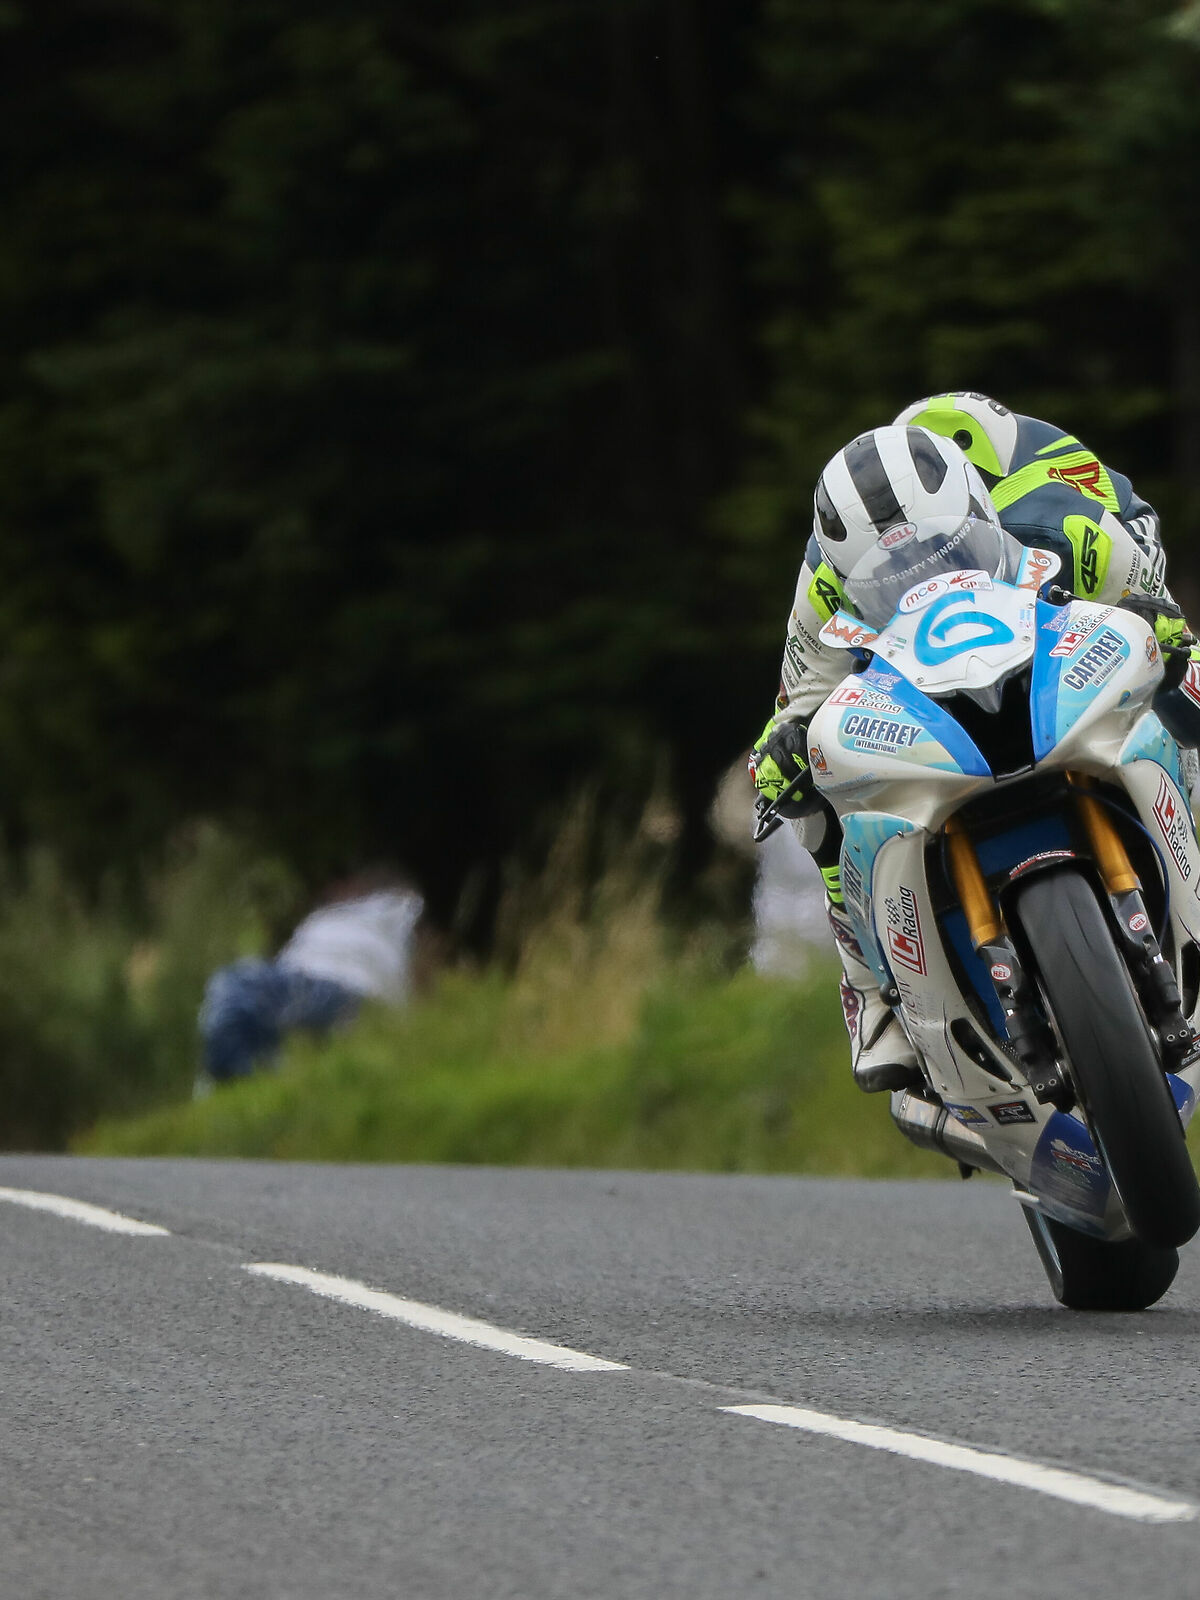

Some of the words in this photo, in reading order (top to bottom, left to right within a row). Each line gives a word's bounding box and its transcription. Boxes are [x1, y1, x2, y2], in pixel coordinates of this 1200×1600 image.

[882, 527, 914, 547] BELL
[882, 559, 926, 585] COUNTY
[927, 524, 971, 565] WINDOWS
[1126, 549, 1137, 585] MAXWELL
[905, 582, 938, 607] mce
[797, 619, 822, 650] MAXWELL
[1080, 606, 1114, 635] Racing
[1063, 630, 1124, 690] CAFFREY
[1093, 654, 1124, 687] INTERNATIONAL
[858, 698, 902, 714] Racing
[844, 715, 922, 747] CAFFREY
[855, 740, 898, 754] INTERNATIONAL
[1168, 825, 1192, 878] Racing
[899, 886, 919, 940] Racing
[1133, 918, 1145, 931] HEL
[992, 970, 1007, 979] HEL
